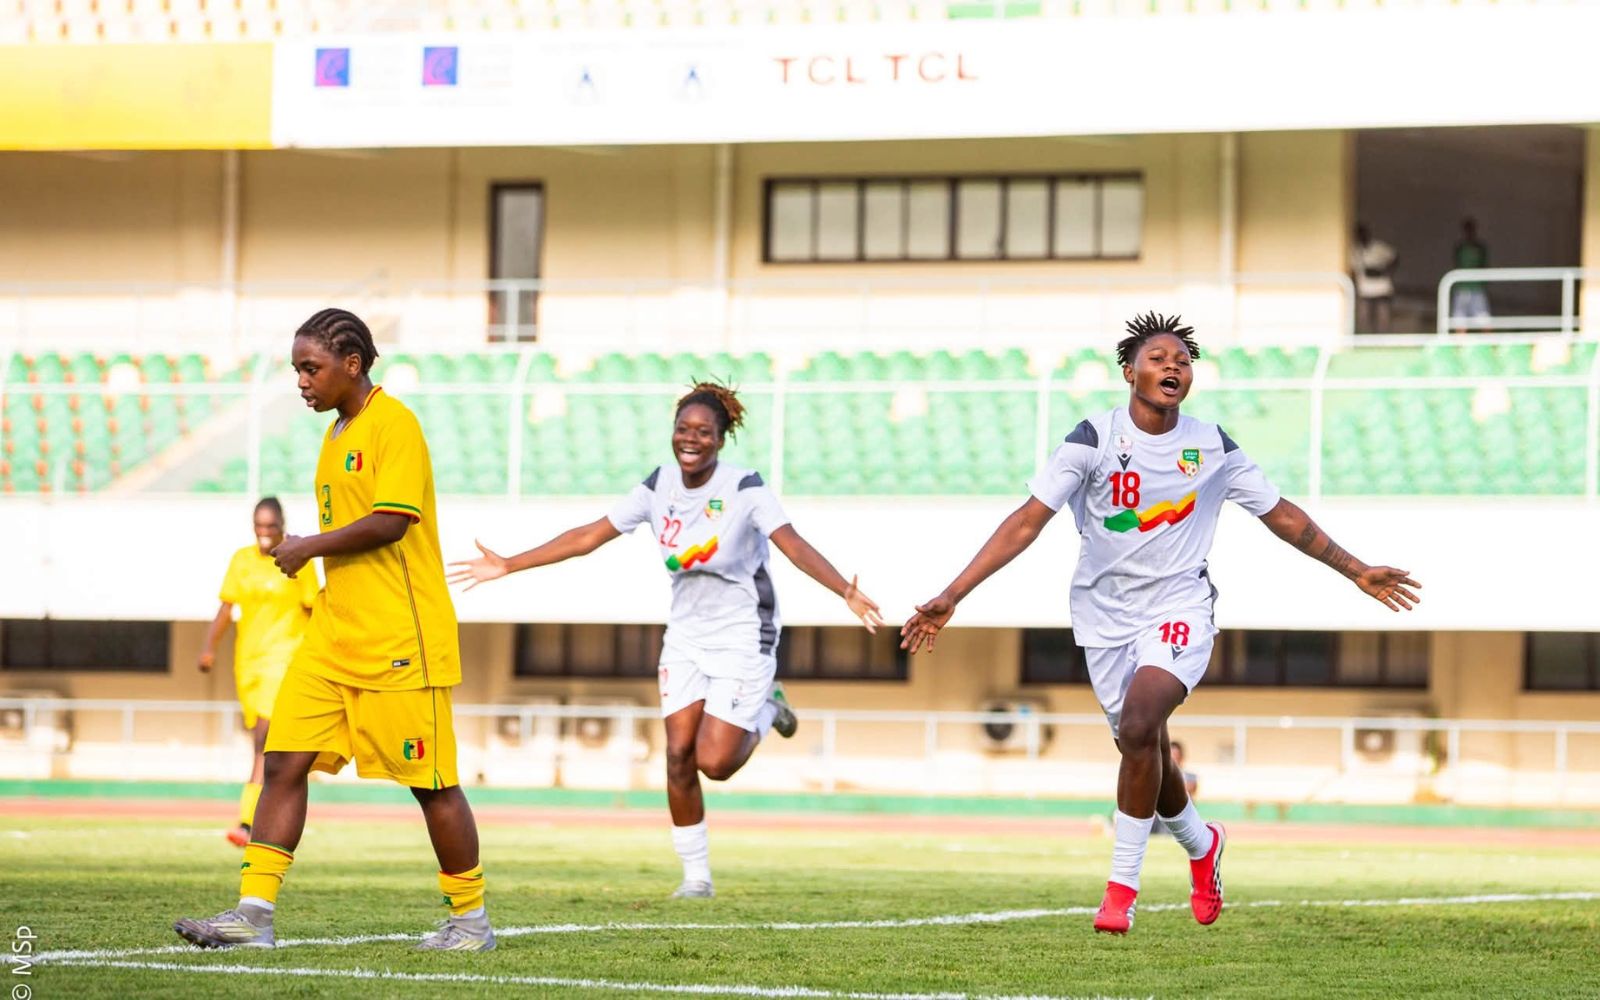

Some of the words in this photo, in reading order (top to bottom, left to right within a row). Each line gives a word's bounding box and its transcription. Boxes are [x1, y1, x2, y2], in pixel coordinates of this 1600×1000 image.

[773, 56, 866, 84] TCL
[882, 53, 979, 81] TCL
[1109, 471, 1140, 508] 18
[660, 516, 681, 547] 22
[1159, 621, 1190, 646] 18
